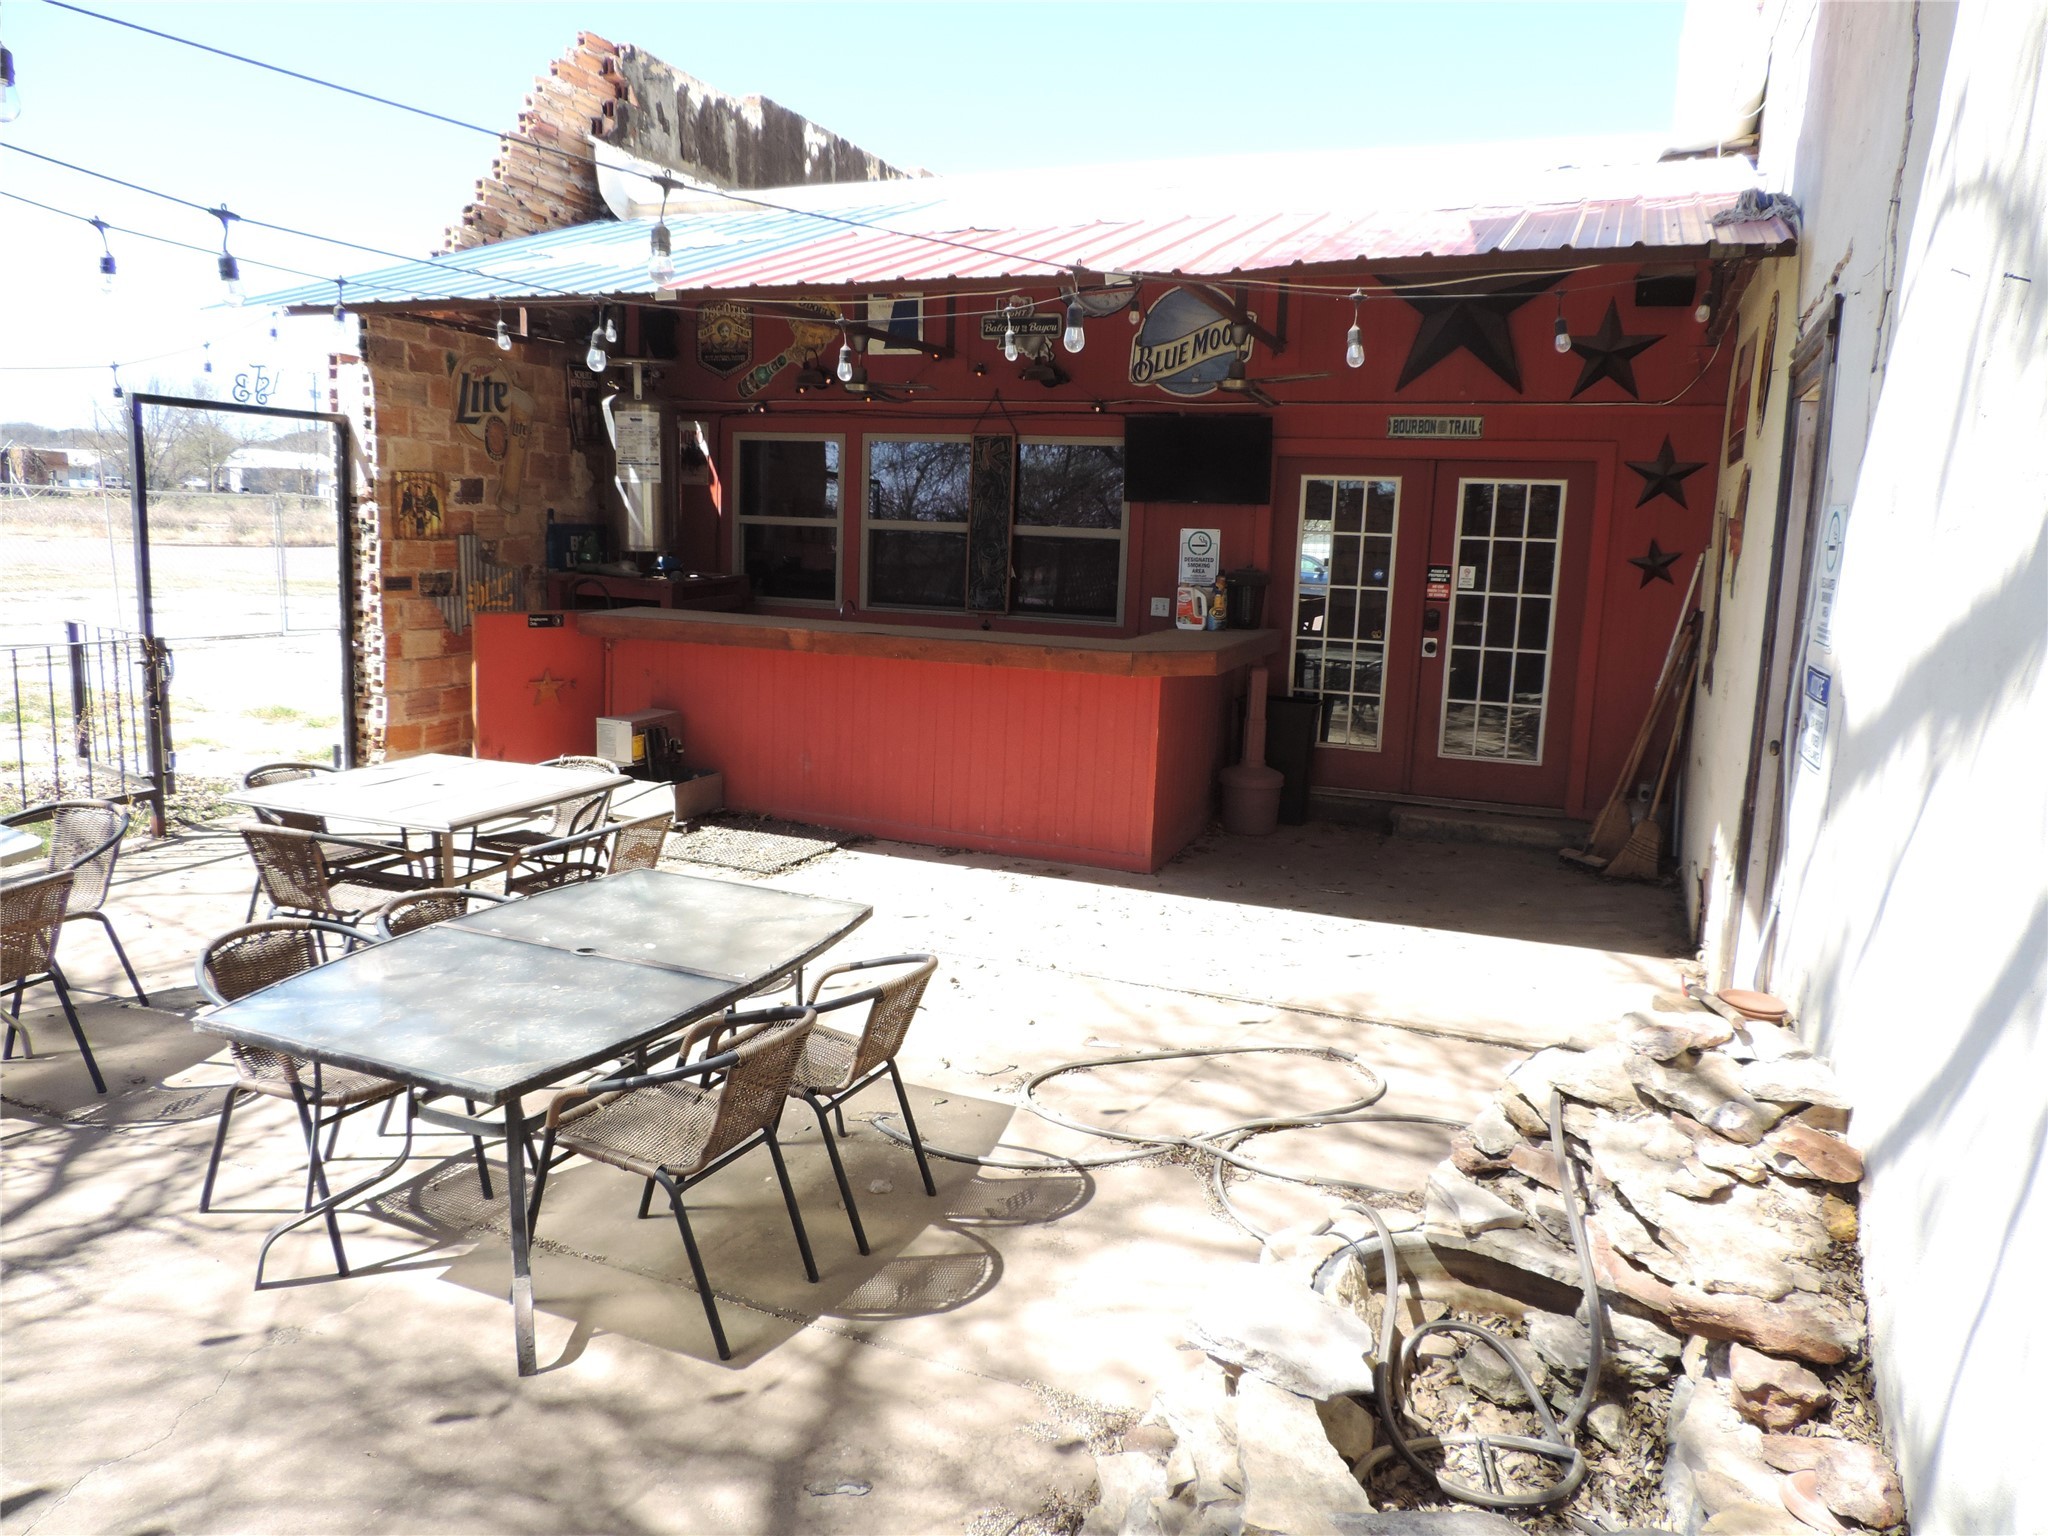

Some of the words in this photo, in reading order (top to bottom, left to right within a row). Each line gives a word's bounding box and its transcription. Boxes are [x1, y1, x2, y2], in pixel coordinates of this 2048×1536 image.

[1028, 322, 1057, 333] Bayou
[1133, 341, 1189, 382] BLUE
[1192, 321, 1234, 359] MOO
[455, 372, 509, 425] Lite
[1392, 419, 1437, 434] BOURBON
[1449, 419, 1477, 434] TRAIL
